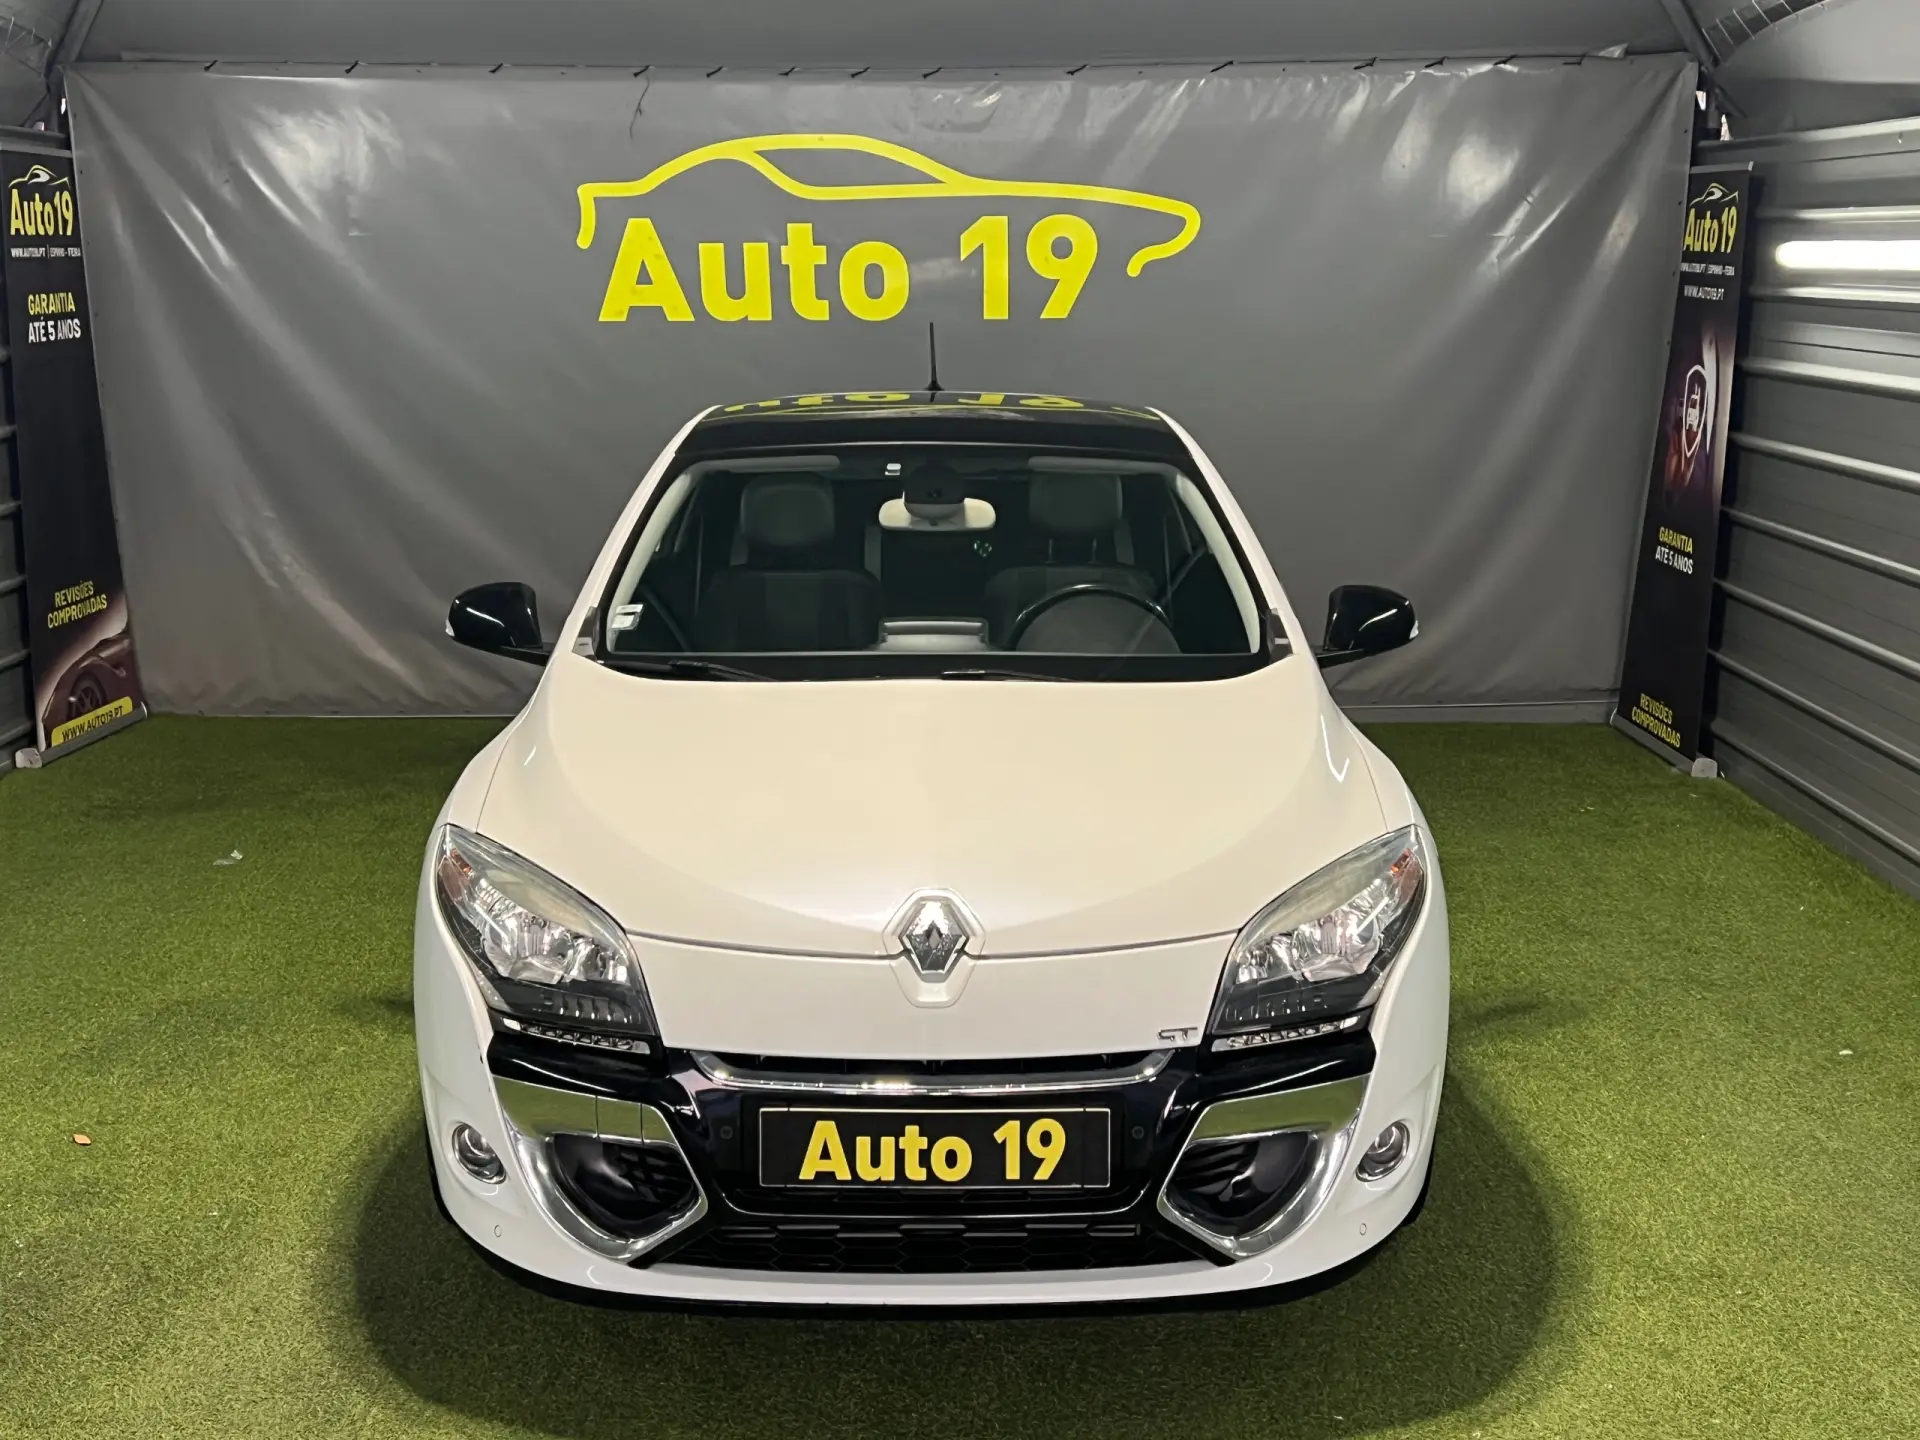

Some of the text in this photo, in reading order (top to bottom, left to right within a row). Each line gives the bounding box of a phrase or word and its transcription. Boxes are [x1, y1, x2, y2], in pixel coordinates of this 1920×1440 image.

[598, 214, 1099, 322] Auto 19
[28, 291, 76, 316] GARANTIA
[28, 315, 81, 344] ATÉ 5 ANOS
[1659, 526, 1693, 554] GARANTIA
[1655, 545, 1694, 575] ATÉ 5 ANOS
[54, 580, 94, 608] REVISÕES
[47, 593, 107, 629] COMPROVADAS
[1640, 692, 1673, 724] REVISÕES
[1631, 706, 1681, 748] COMPROVADAS
[798, 1118, 1066, 1182] Auto 19
